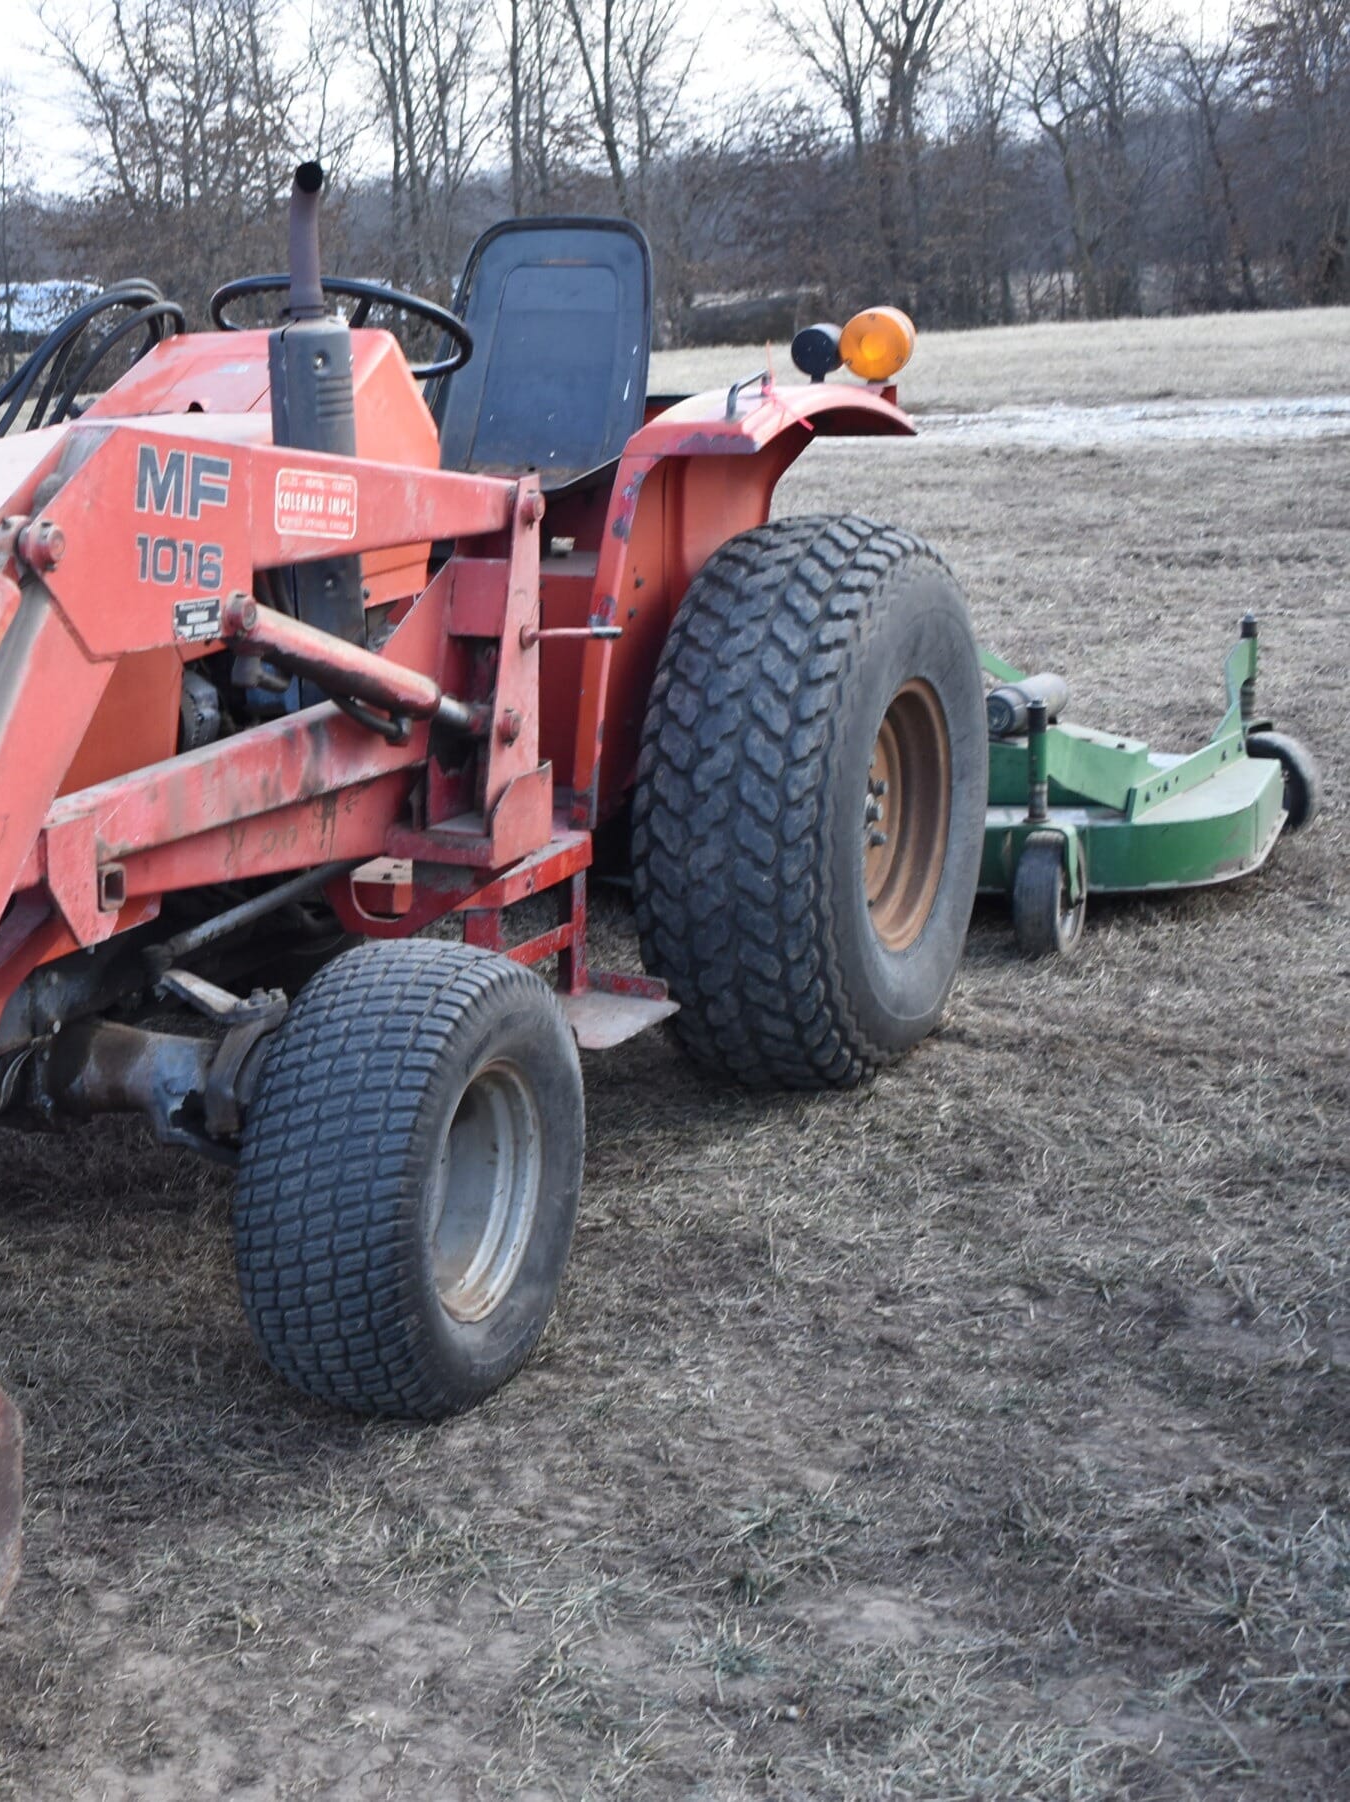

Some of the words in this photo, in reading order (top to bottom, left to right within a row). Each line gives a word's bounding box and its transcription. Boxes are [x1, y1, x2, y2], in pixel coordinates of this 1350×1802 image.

[135, 444, 231, 520] MF
[277, 490, 324, 513] COLEMAN
[135, 533, 223, 590] 1016
